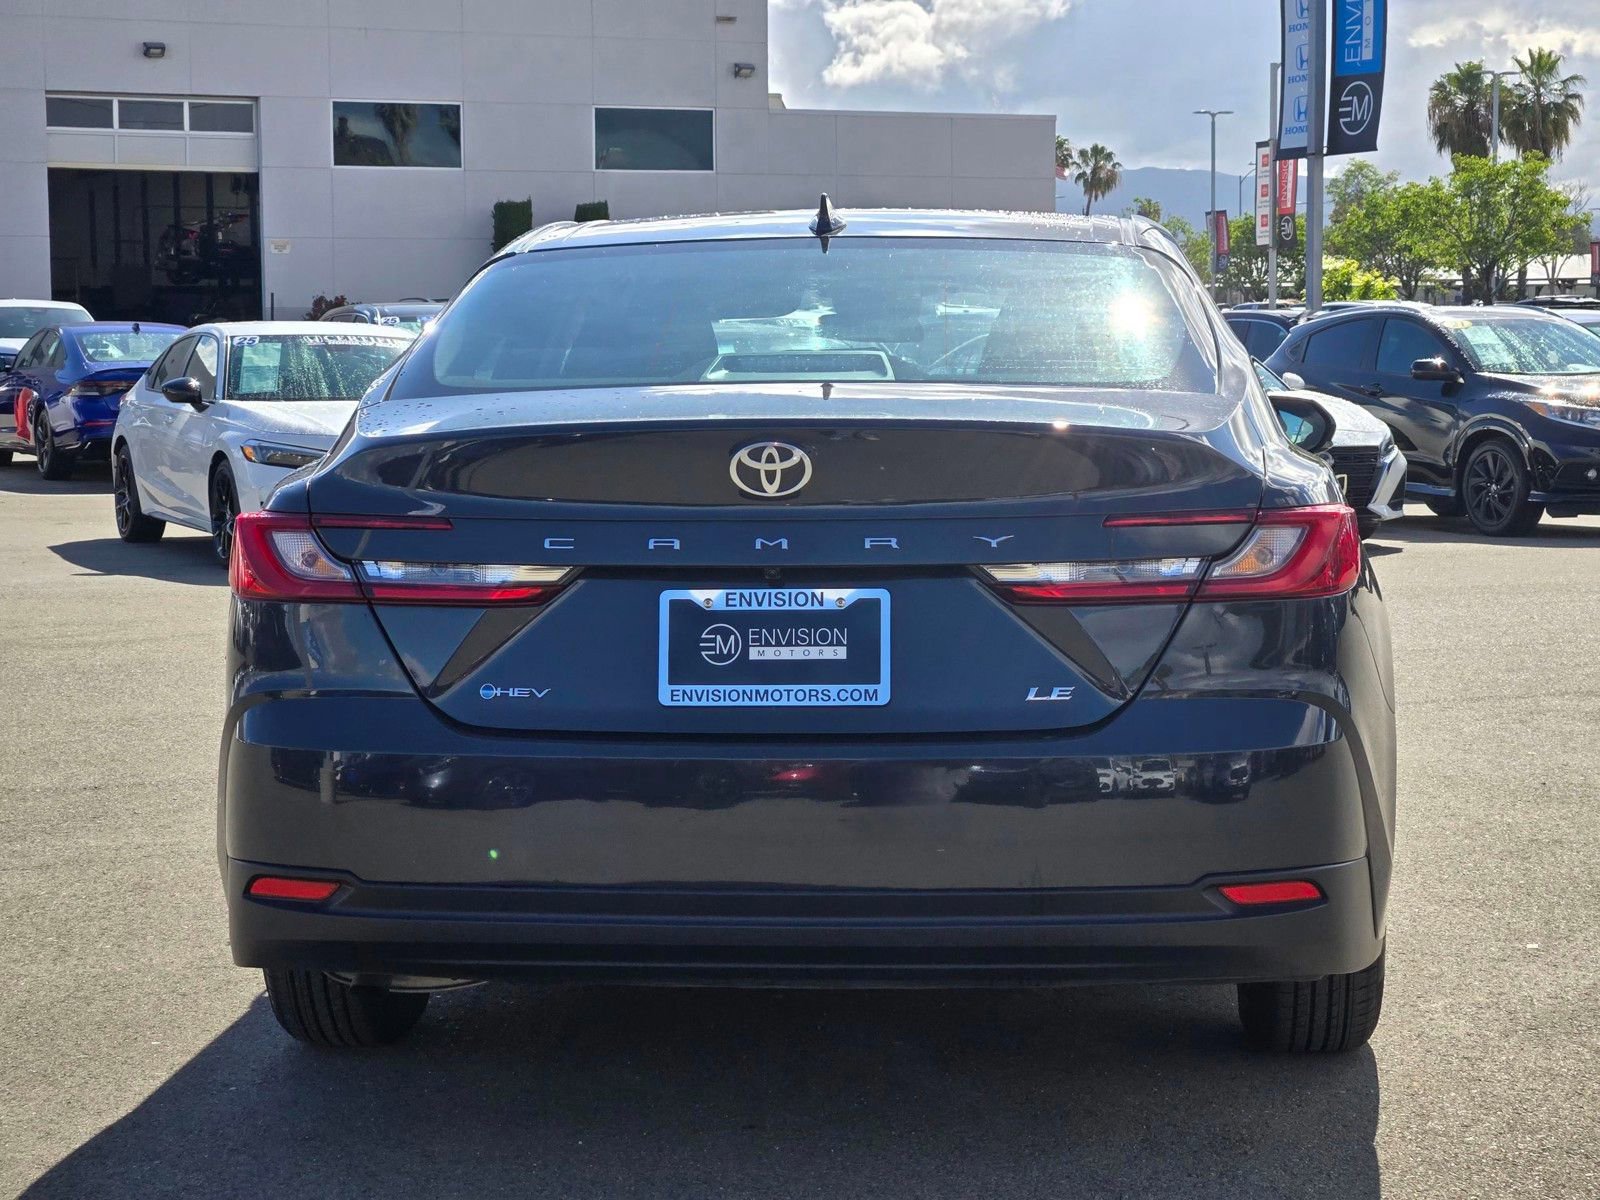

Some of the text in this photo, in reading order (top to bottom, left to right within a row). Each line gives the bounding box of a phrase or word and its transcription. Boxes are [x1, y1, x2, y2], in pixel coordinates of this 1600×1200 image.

[1288, 22, 1308, 33] HON
[1287, 74, 1308, 84] HON
[237, 337, 256, 346] 25
[543, 534, 1015, 551] CAMRY
[725, 591, 824, 608] ENVISION
[748, 628, 848, 646] ENVISION
[757, 648, 839, 658] MOTORS
[670, 688, 879, 703] ENVISIONMOTORS.COM
[1025, 686, 1075, 701] LE
